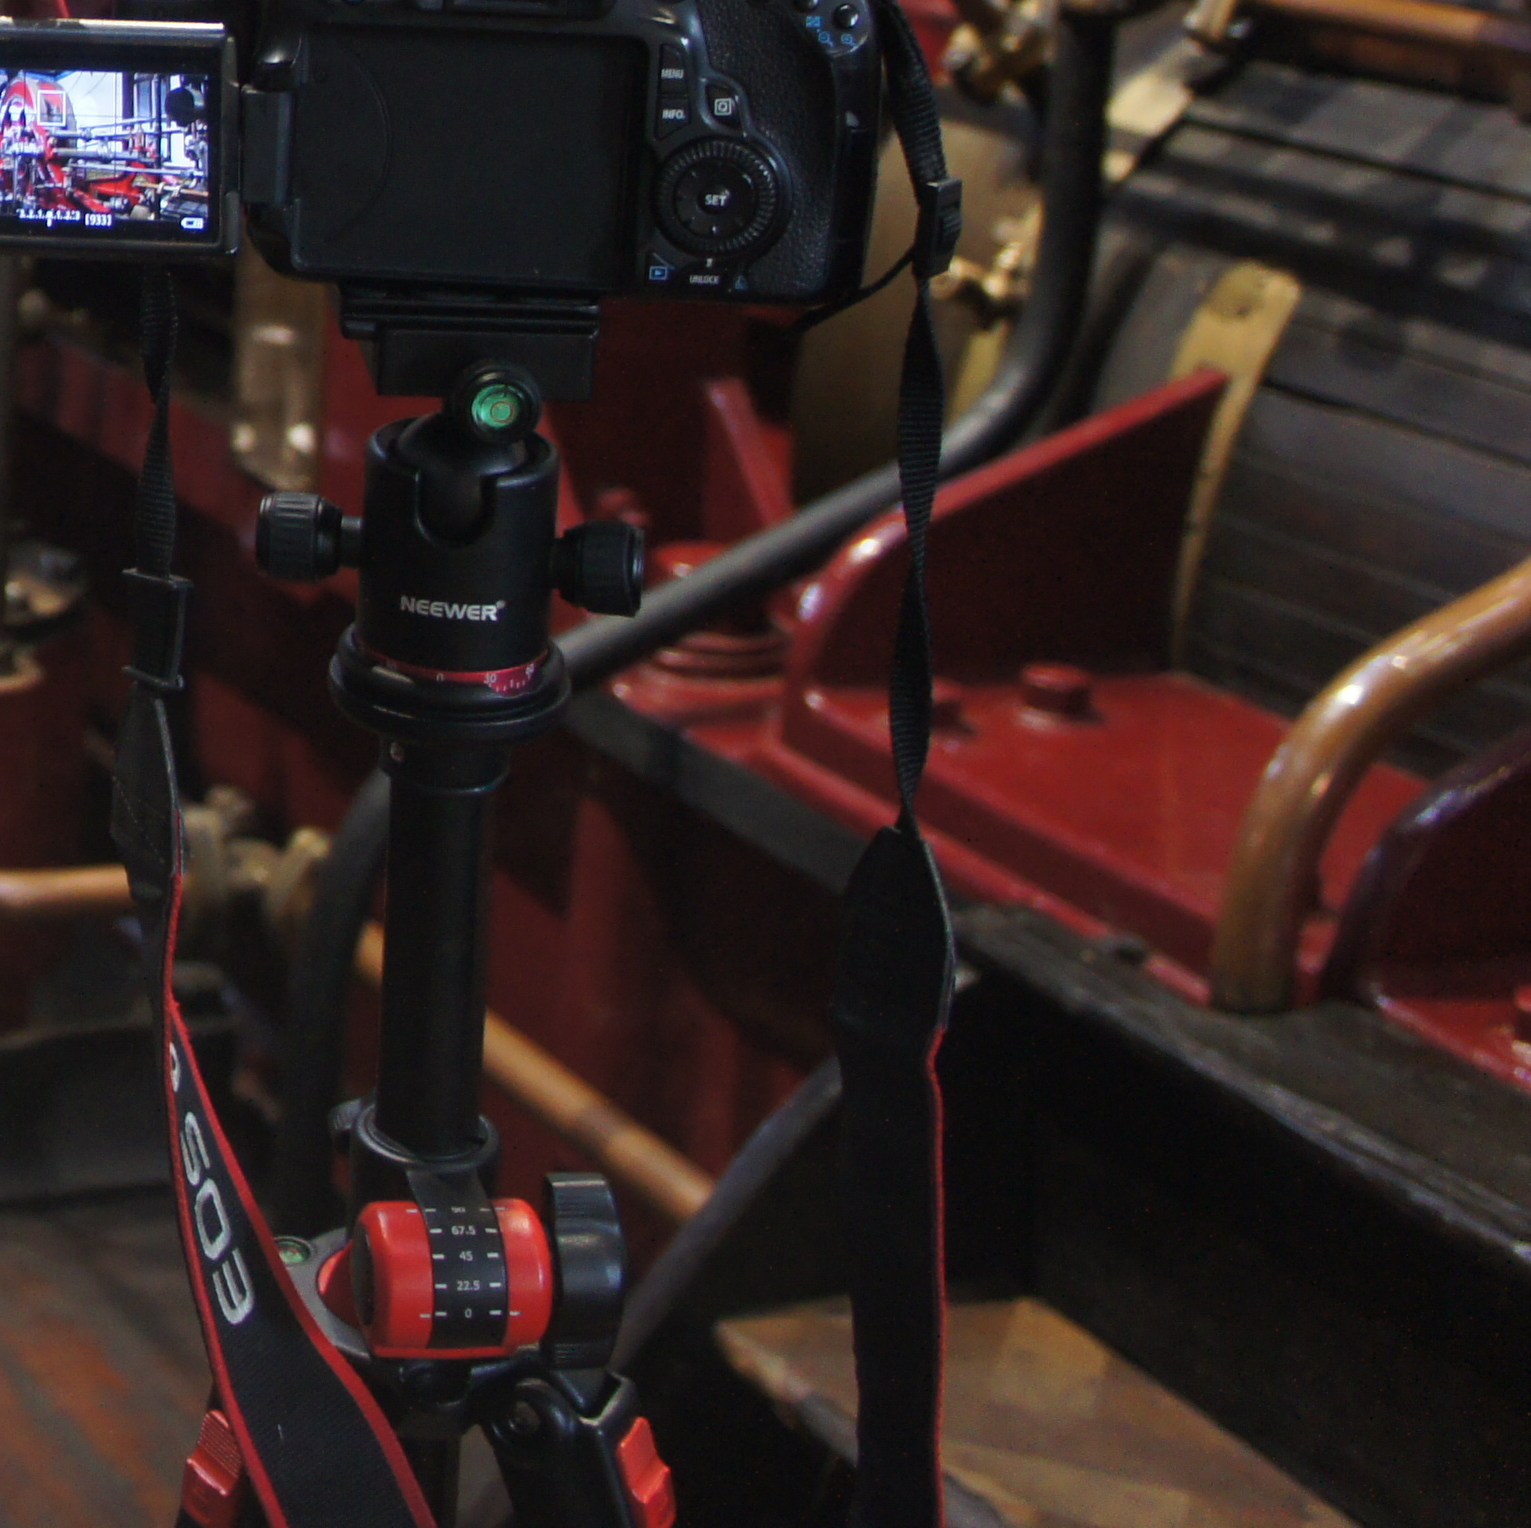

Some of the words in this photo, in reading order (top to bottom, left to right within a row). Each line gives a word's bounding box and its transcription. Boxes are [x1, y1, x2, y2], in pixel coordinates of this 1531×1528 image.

[661, 68, 684, 79] MENU
[705, 194, 727, 206] SET
[179, 1110, 255, 1325] EOS
[451, 1225, 476, 1235] 67.5
[459, 1251, 474, 1261] 45
[457, 1280, 481, 1291] 22.5
